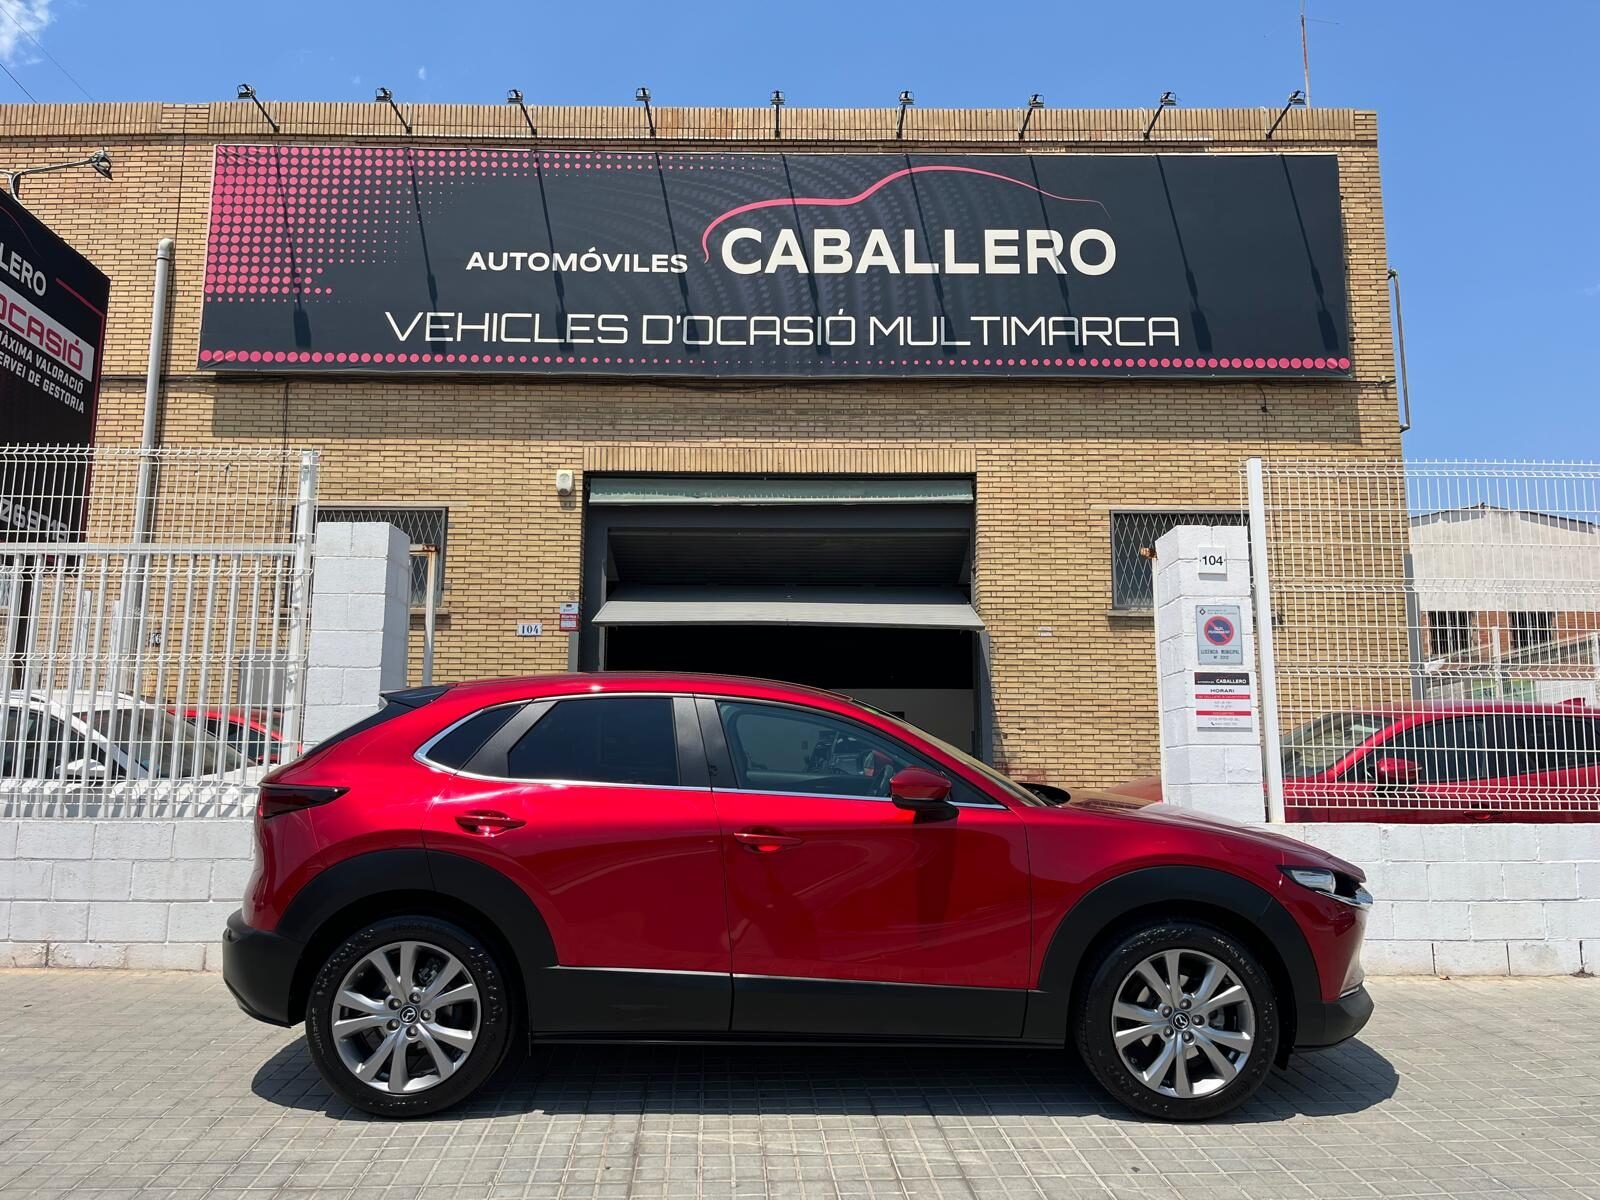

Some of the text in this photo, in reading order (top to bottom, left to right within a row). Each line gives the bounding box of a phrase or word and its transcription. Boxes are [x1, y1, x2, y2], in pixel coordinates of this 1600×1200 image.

[465, 227, 1117, 276] AUTOMÓVILES CABALLERO
[385, 308, 1180, 347] VEHICLES D'OCASIÓ MULTIMARCA
[0, 330, 84, 394] ÀXIMA VALORACIÓ
[27, 370, 41, 387] DE
[42, 379, 84, 414] GESTORIA
[1202, 555, 1224, 566] 104
[521, 625, 539, 635] 104
